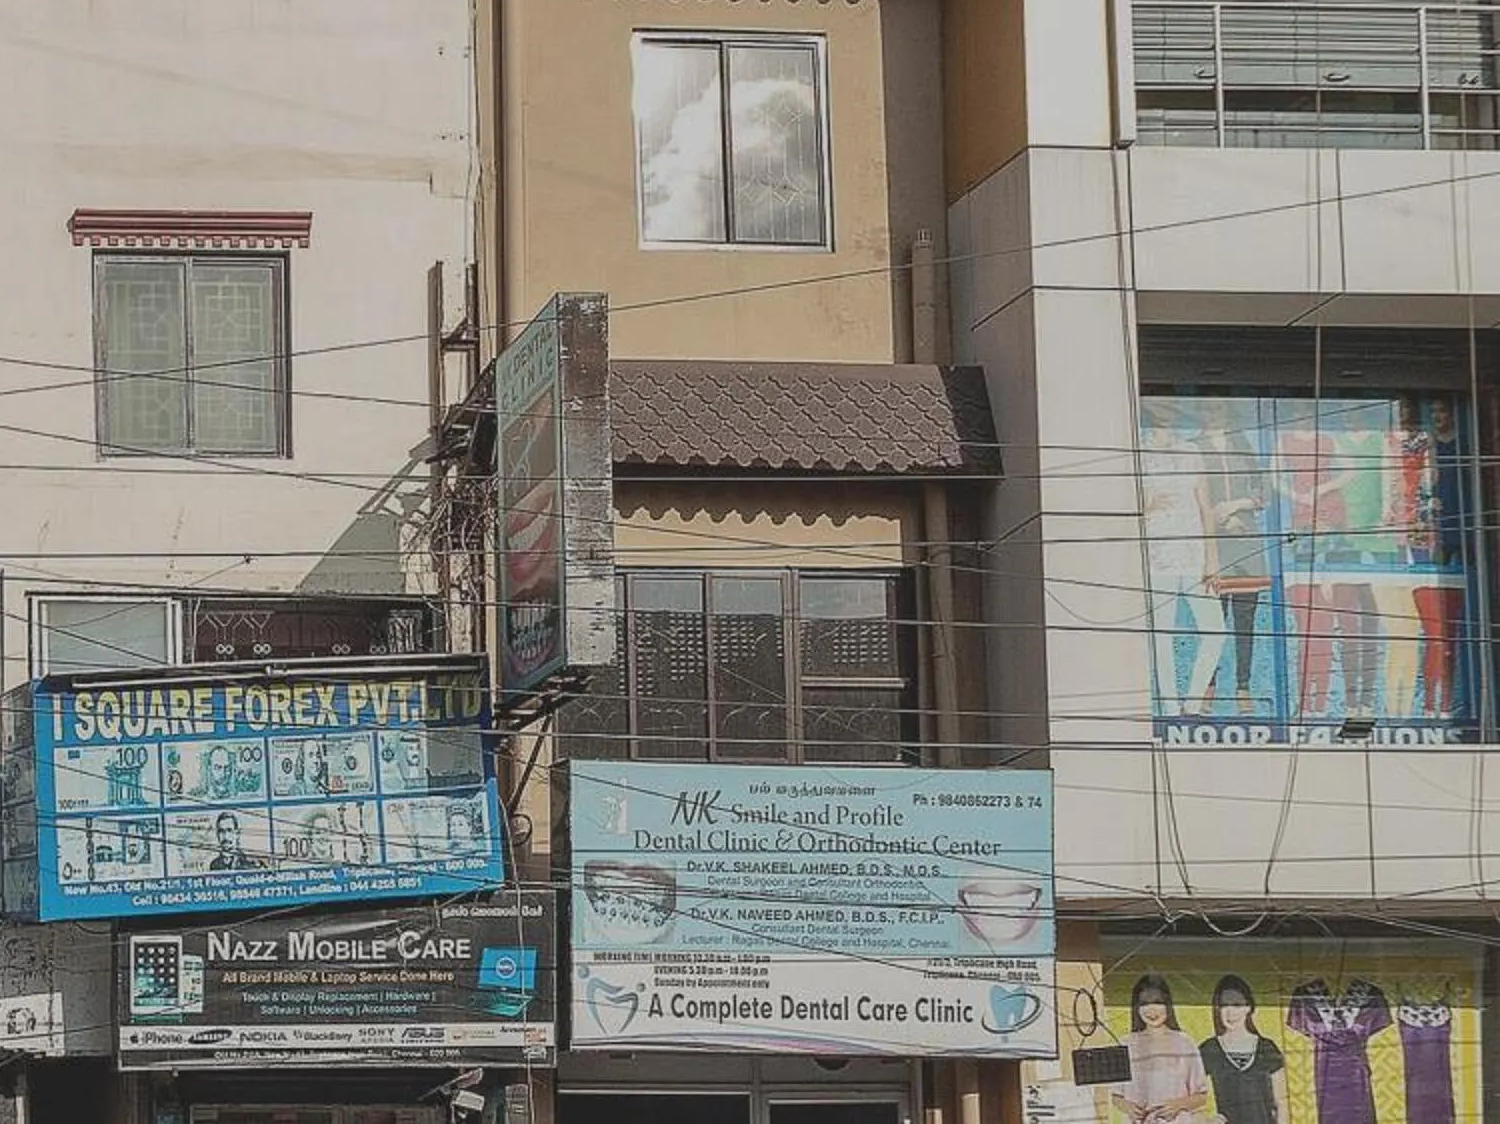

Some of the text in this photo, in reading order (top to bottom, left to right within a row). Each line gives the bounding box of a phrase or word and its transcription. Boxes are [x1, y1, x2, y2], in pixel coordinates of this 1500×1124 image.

[51, 692, 63, 741] I
[74, 687, 215, 743] SQUARE
[225, 682, 340, 733] FOREX
[670, 789, 904, 827] NK Smile and Profile
[1027, 796, 1043, 809] 74
[634, 828, 1003, 857] Dental Clinic & Orthodontic Center
[733, 861, 798, 875] SHAKEEL
[737, 909, 793, 921] NAVEED
[239, 972, 271, 983] Brand
[273, 972, 307, 983] Mobile
[321, 972, 357, 986] Laptop
[358, 971, 397, 983] Service
[399, 971, 428, 982] Done
[429, 970, 455, 982] Here
[281, 991, 316, 1005] Display
[647, 992, 974, 1025] A Complete Dental Care Clinic
[142, 1030, 183, 1046] iPhone
[239, 1030, 288, 1044] NOKIA
[358, 1027, 396, 1037] SONY
